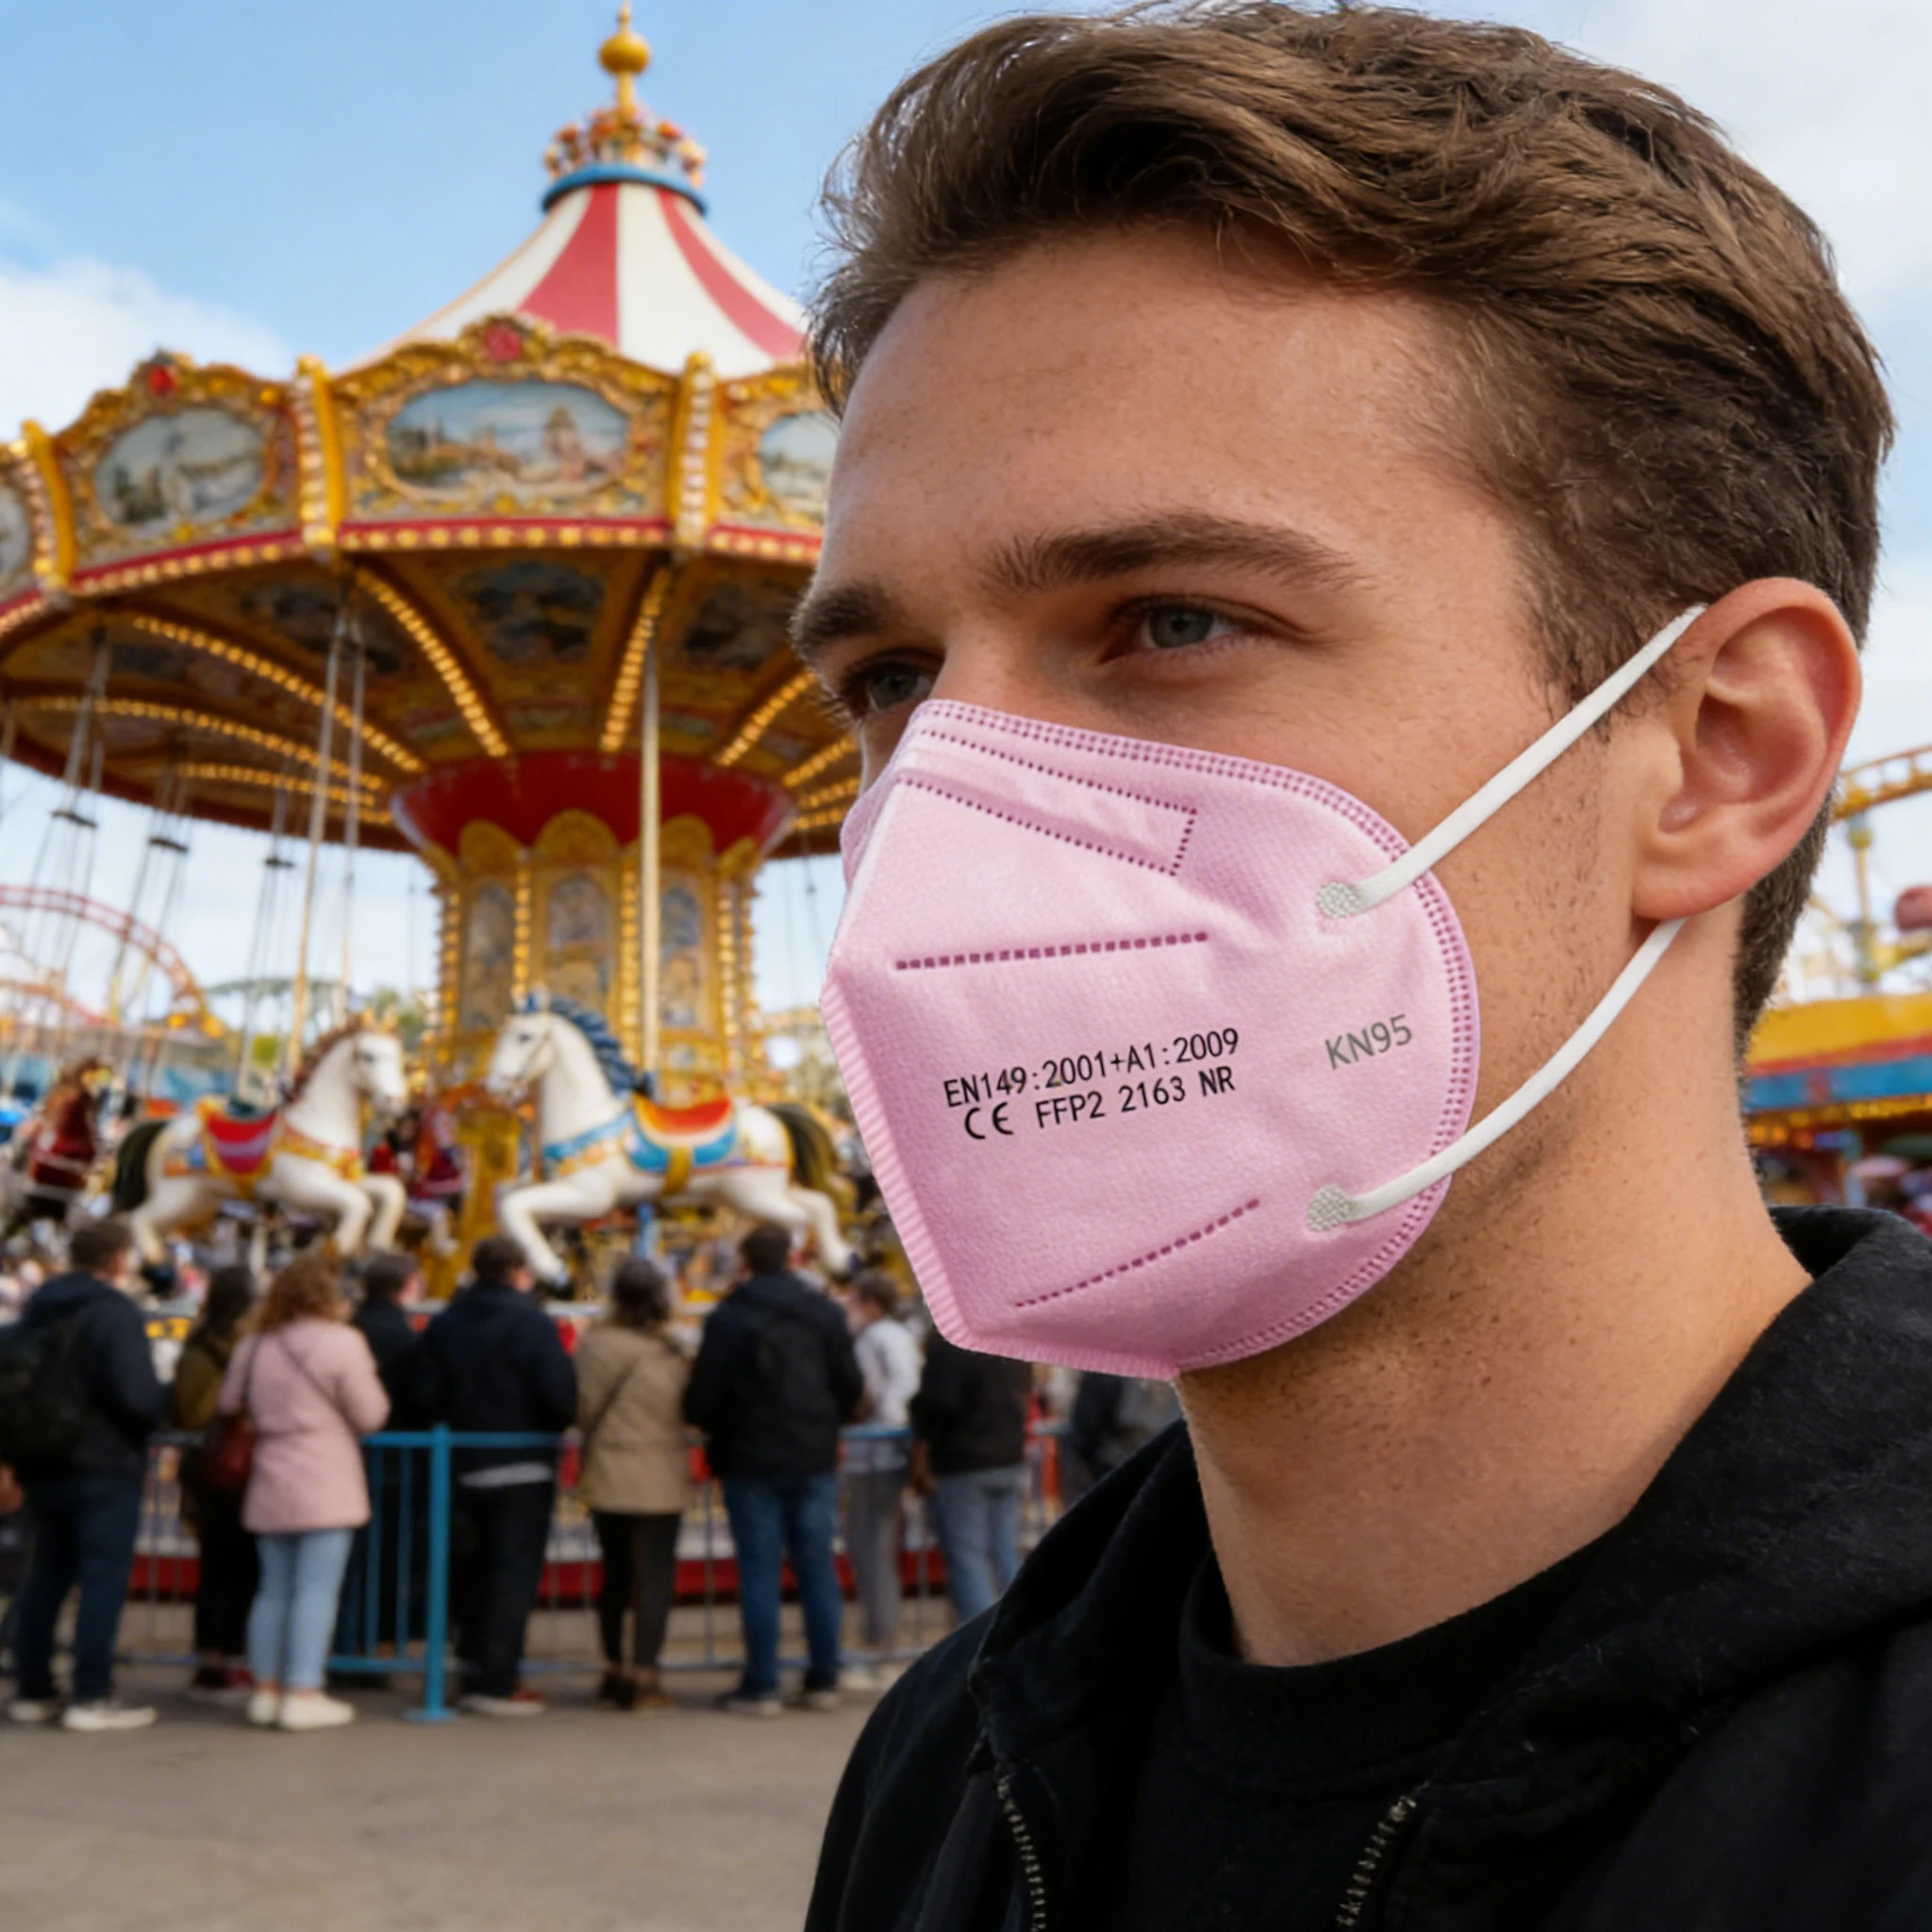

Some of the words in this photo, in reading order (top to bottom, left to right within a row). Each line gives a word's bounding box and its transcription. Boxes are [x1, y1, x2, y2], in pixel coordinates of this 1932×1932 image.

[943, 1027, 1239, 1108] EN149:2001+A1:2009
[1324, 1013, 1412, 1070] KN95
[964, 1102, 1014, 1140] CE
[1035, 1091, 1106, 1128] FFP2
[1118, 1075, 1186, 1112] 2163
[1198, 1066, 1236, 1097] NR
